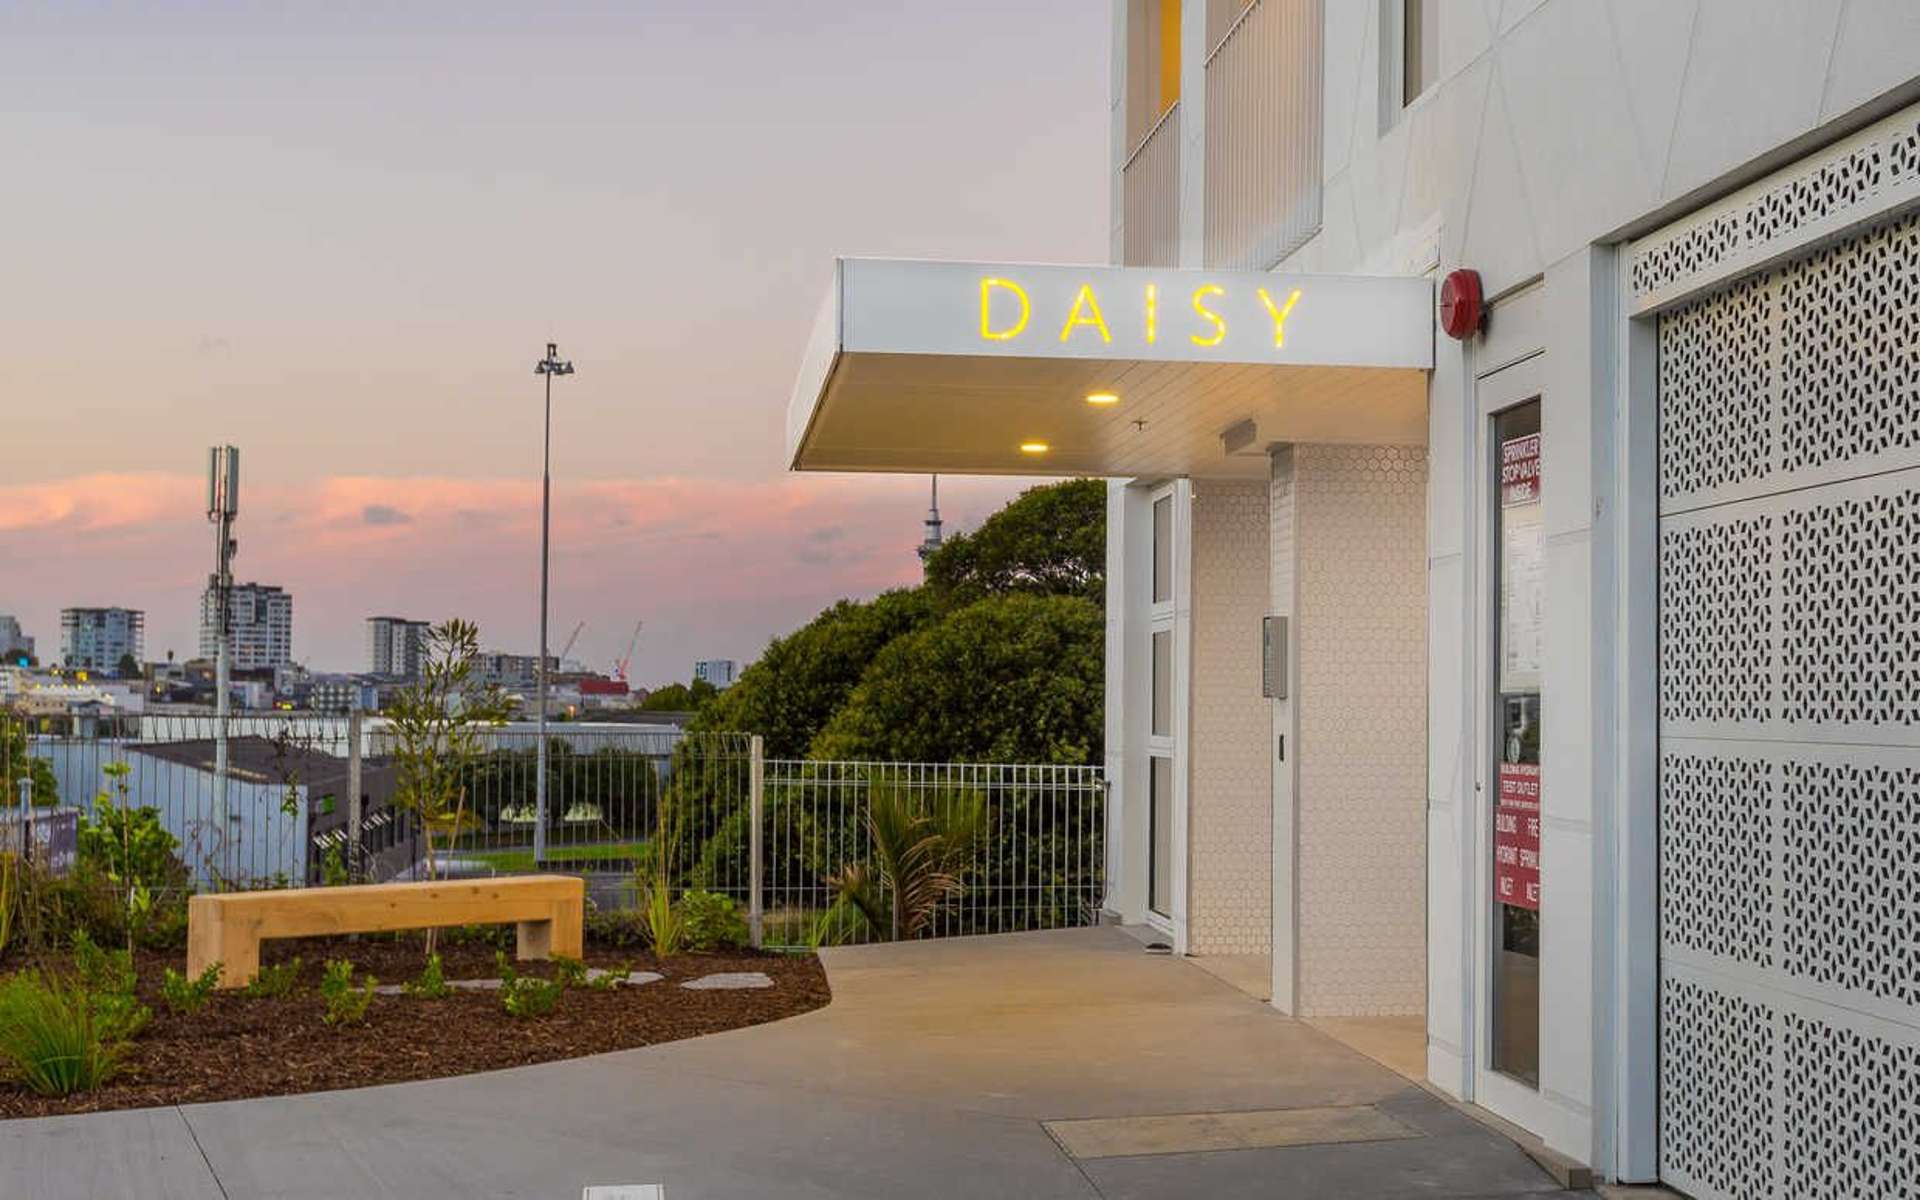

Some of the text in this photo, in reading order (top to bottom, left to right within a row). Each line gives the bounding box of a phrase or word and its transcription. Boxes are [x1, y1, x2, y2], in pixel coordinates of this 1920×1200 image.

[979, 276, 1303, 350] DAISY
[1503, 438, 1538, 464] SPRINKLER
[1502, 461, 1520, 484] STOP
[1502, 780, 1538, 796] TEST OUTLET
[1527, 817, 1539, 838] FIRE
